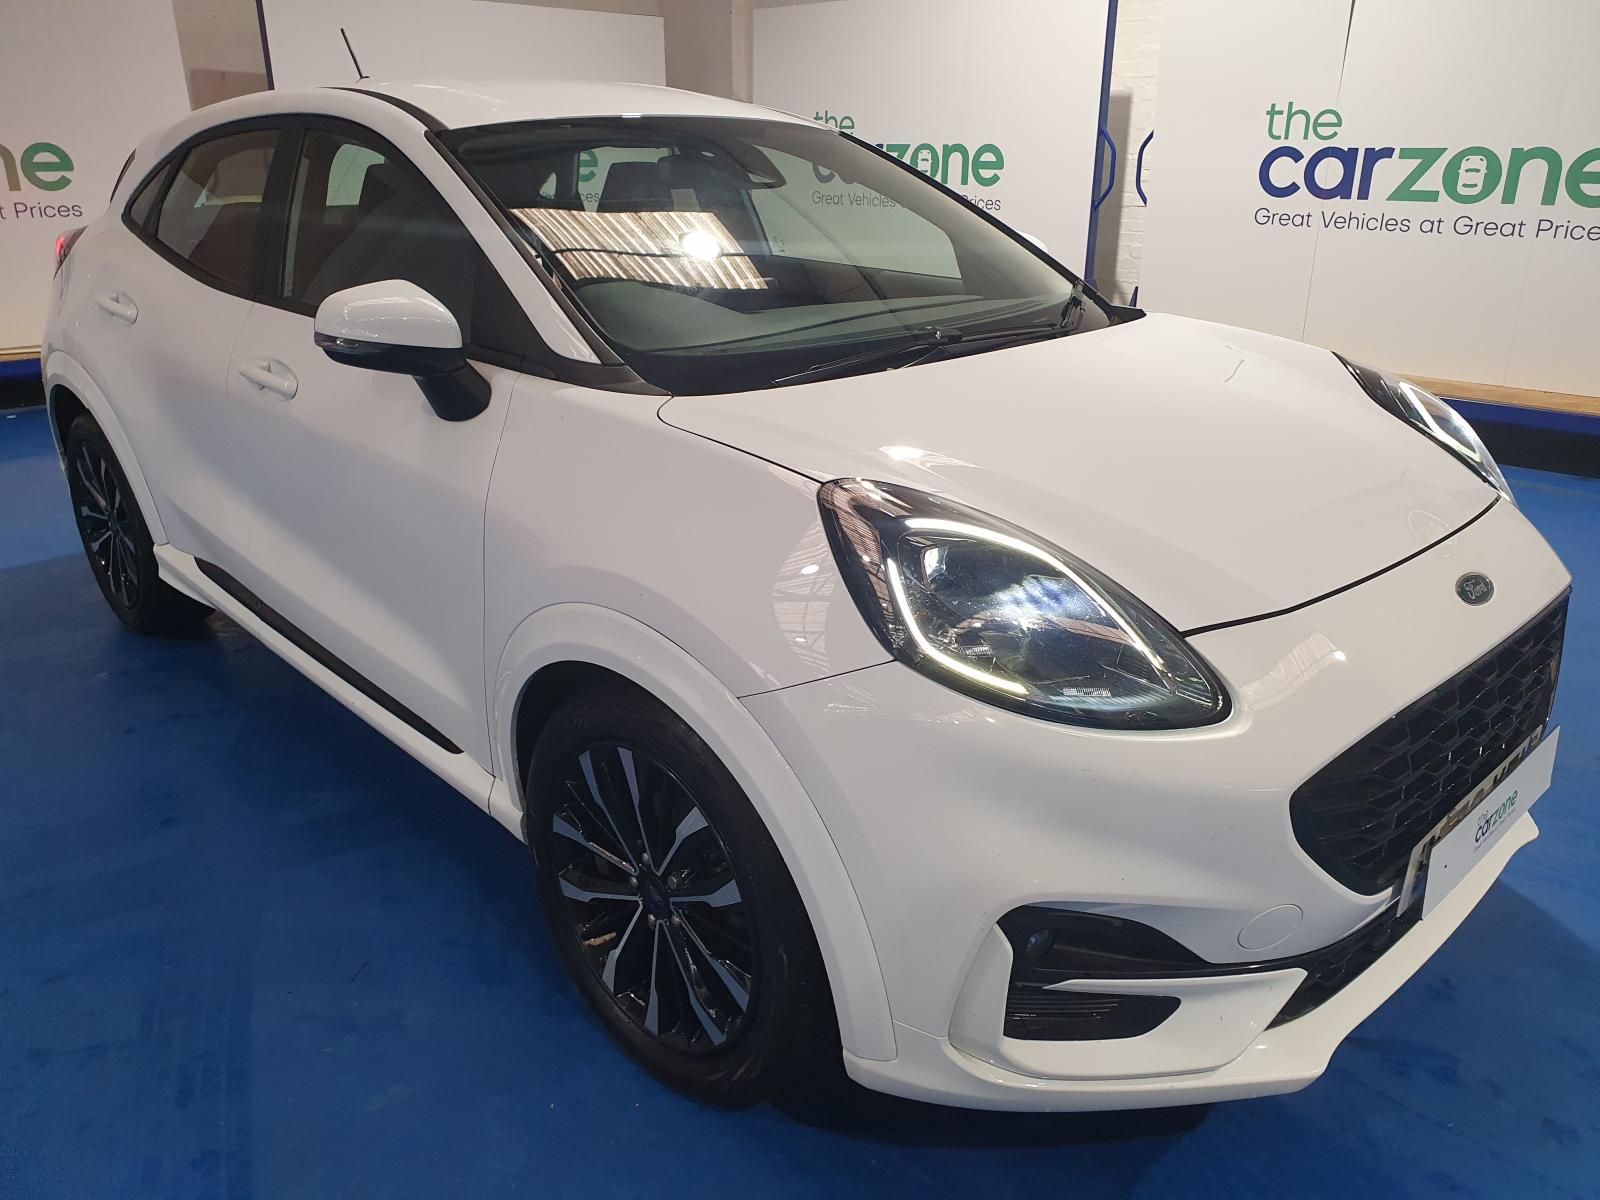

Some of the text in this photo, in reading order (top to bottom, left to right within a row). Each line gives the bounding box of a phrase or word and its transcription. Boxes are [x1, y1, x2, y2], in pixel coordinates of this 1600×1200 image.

[1266, 102, 1342, 140] the
[13, 201, 83, 220] Prices
[811, 190, 844, 206] Great
[847, 192, 897, 208] Vehicles
[1254, 207, 1312, 228] Great
[1321, 211, 1411, 233] Vehicles
[1419, 216, 1444, 235] at
[1453, 215, 1526, 238] Great
